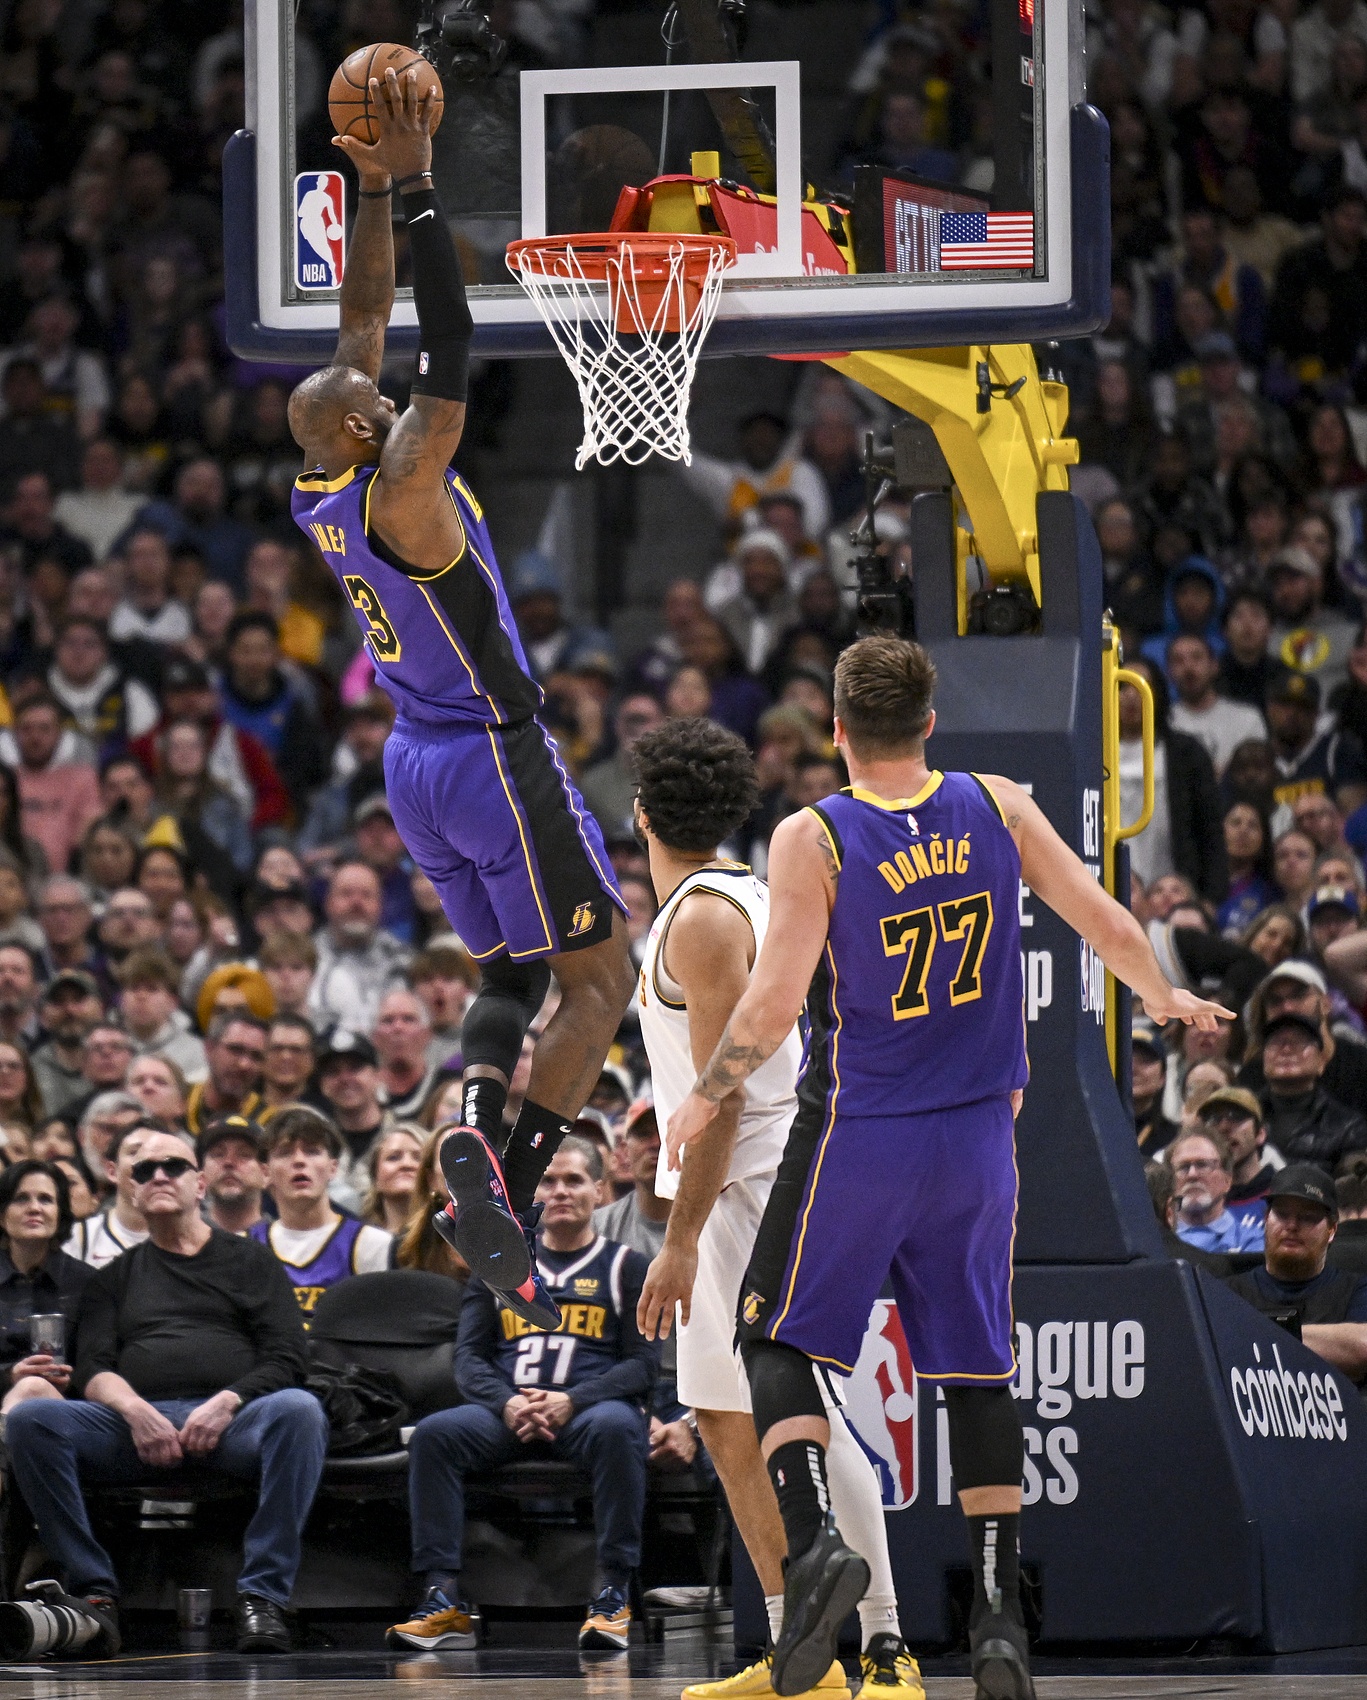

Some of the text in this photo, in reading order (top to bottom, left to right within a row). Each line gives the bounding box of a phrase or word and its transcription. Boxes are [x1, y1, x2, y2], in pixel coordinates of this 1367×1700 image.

[302, 263, 327, 283] NBA
[1083, 788, 1100, 857] GET
[876, 832, 972, 895] DONČIĆ
[879, 890, 995, 1022] 77
[514, 1334, 577, 1385] 27
[1230, 1342, 1348, 1442] coinbase
